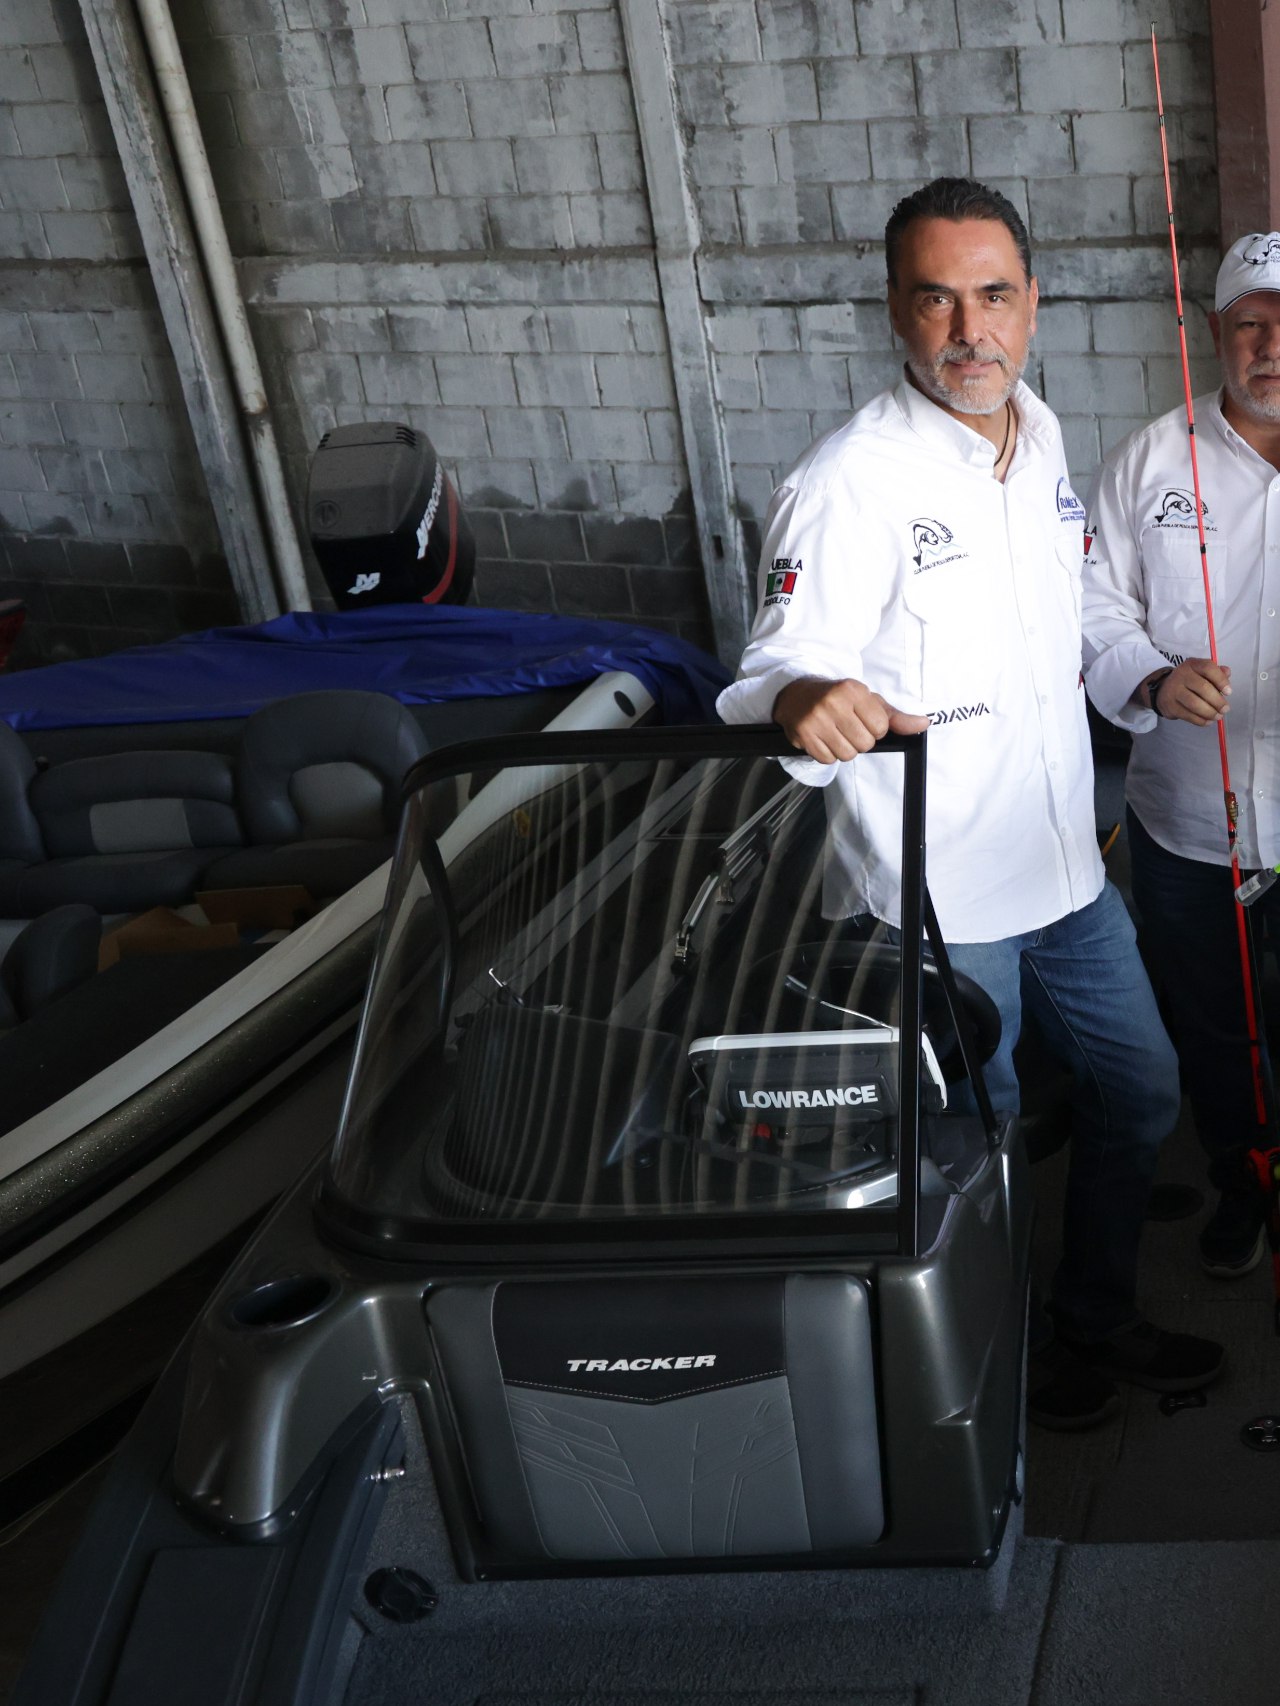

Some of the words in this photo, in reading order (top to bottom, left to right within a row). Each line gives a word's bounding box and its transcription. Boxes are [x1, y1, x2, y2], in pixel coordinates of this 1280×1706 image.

[771, 557, 803, 571] UEBLA
[738, 1084, 879, 1110] LOWRANCE
[566, 1354, 717, 1372] TRACKER
